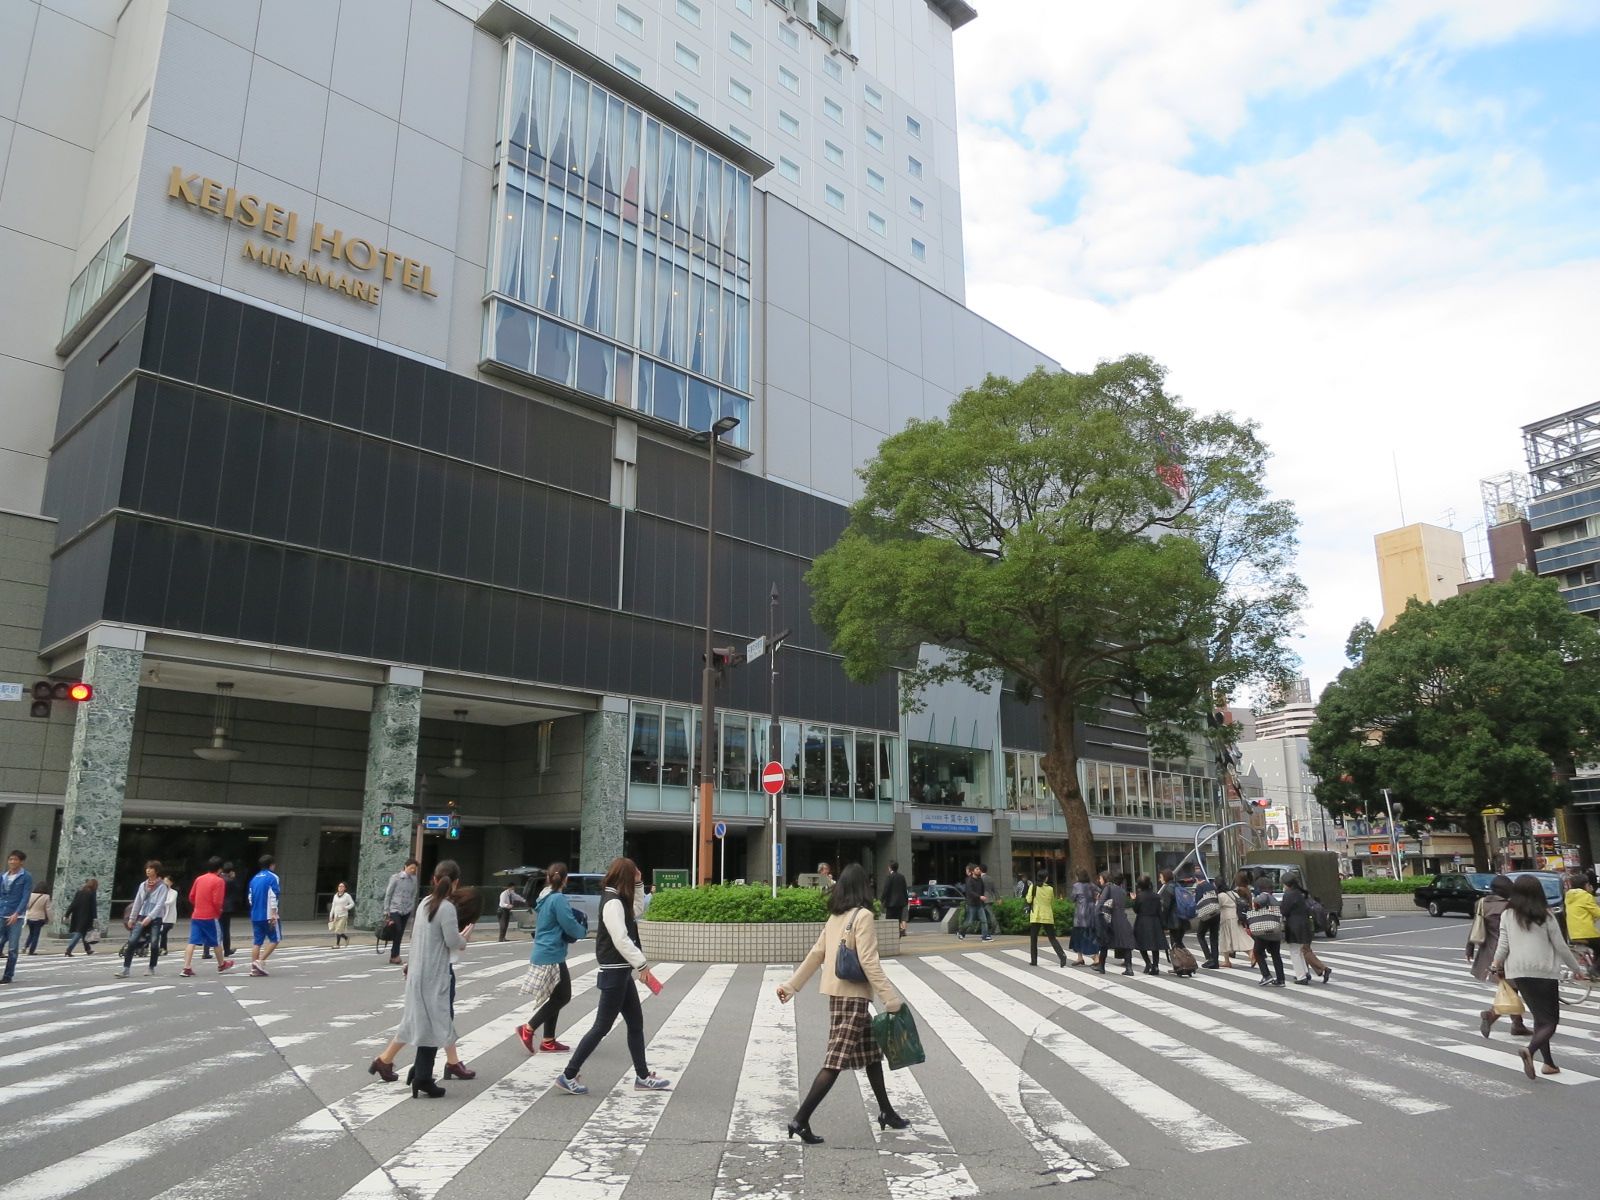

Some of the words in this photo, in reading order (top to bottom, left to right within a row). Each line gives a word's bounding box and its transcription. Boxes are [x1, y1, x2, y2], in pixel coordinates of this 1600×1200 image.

[168, 165, 298, 242] KEISEI
[312, 222, 438, 298] HOTEL
[242, 239, 379, 305] MIRAMARE
